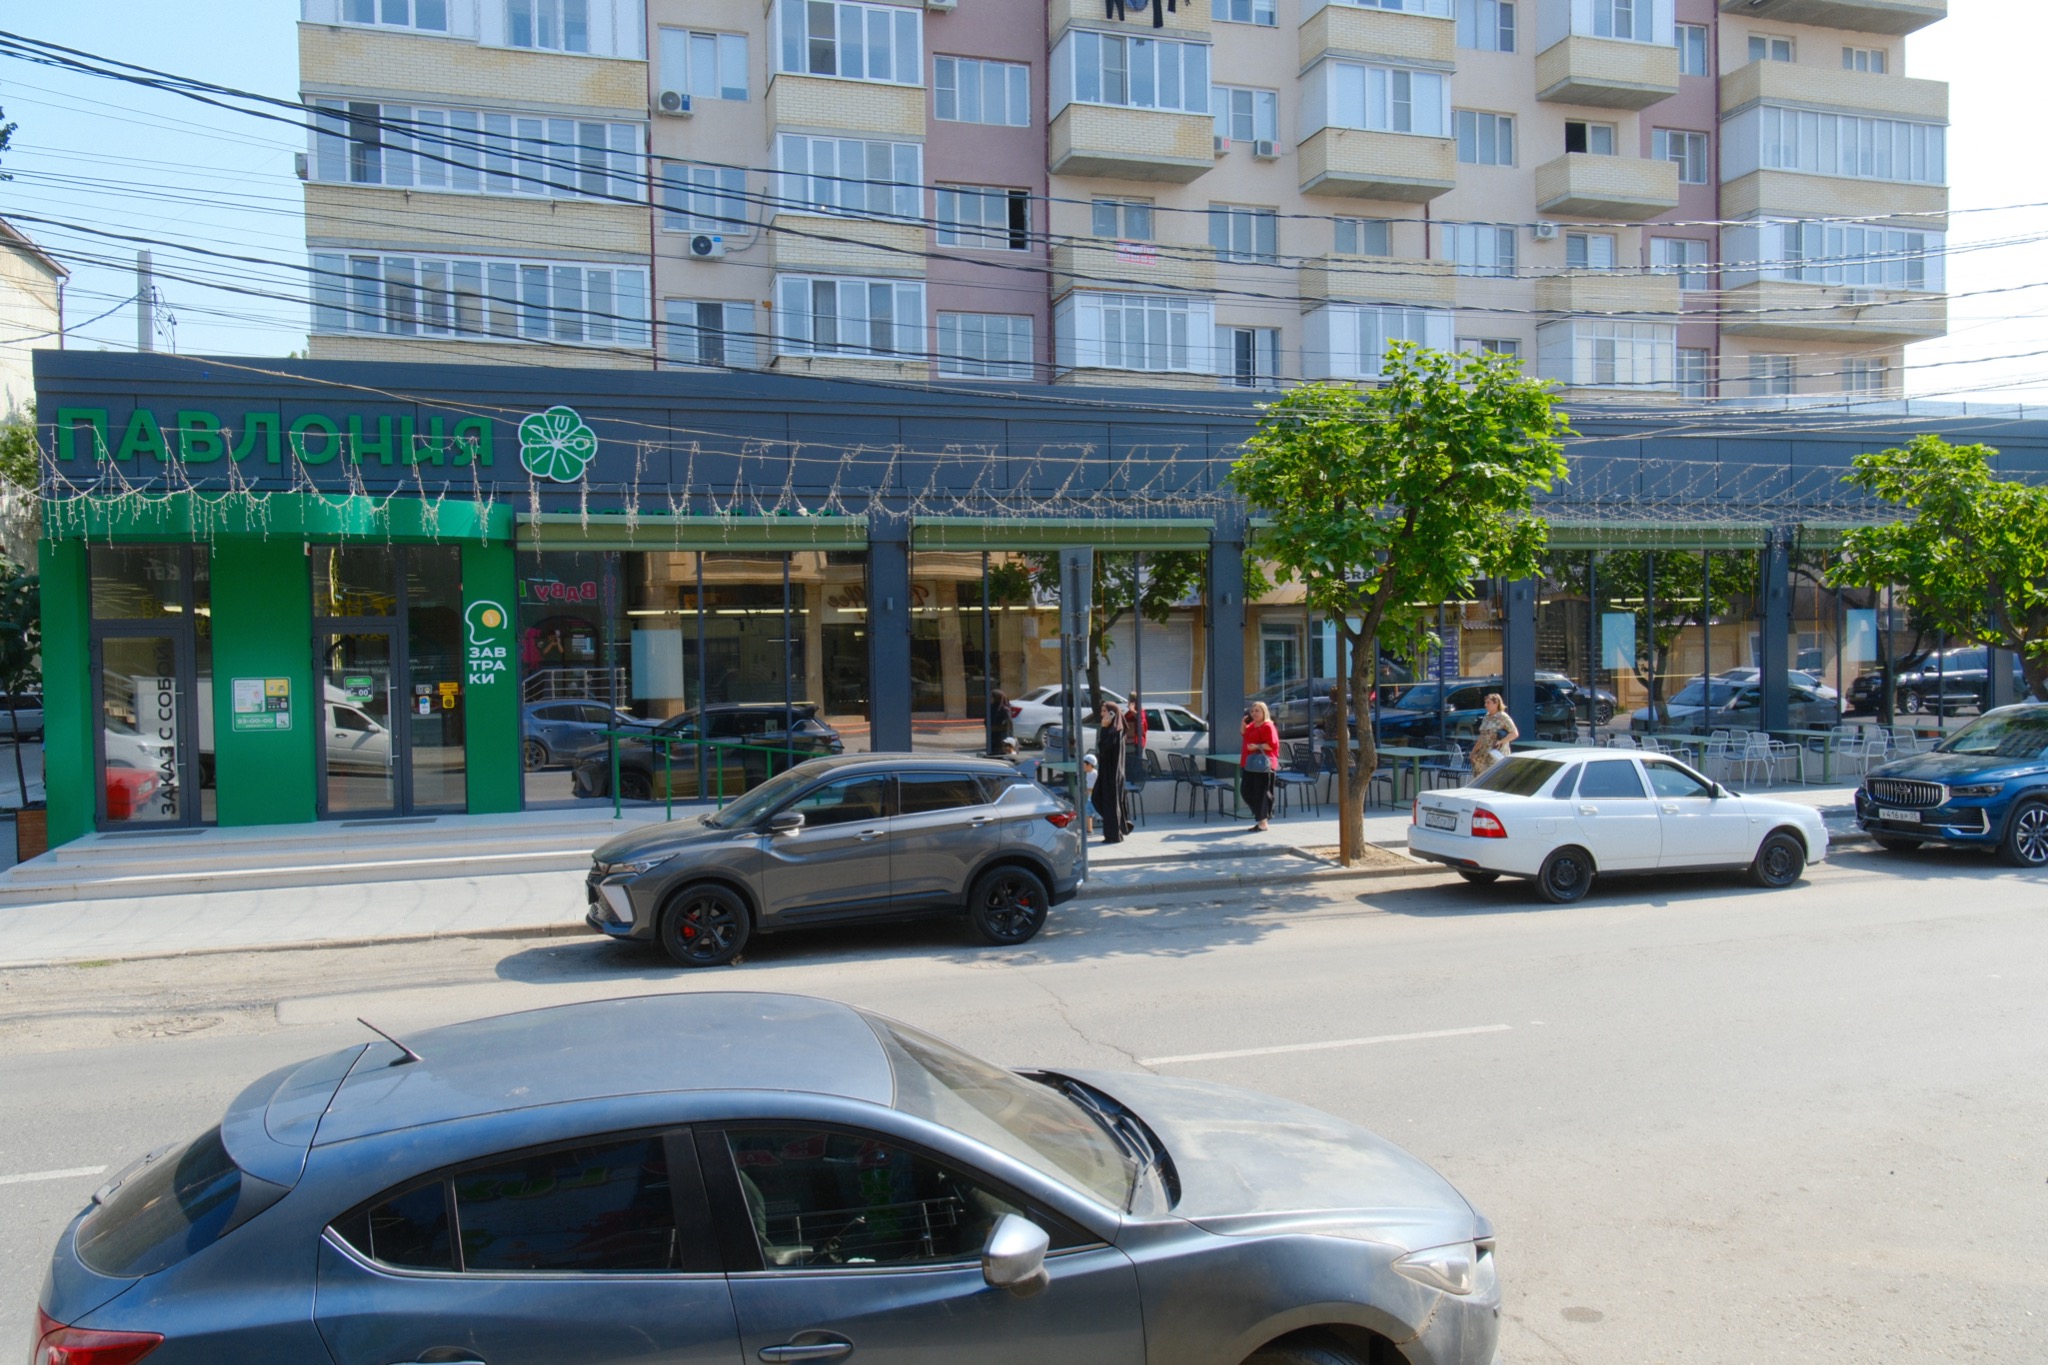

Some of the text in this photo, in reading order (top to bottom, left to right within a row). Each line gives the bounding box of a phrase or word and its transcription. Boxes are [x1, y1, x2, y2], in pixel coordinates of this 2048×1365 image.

[57, 407, 494, 467] ПАВЛОНИЯ
[469, 647, 507, 658] ЗАВ
[468, 660, 507, 671] ТРА
[469, 673, 495, 684] КИ
[156, 645, 176, 815] ЗАКАЗ С СОБОЙ
